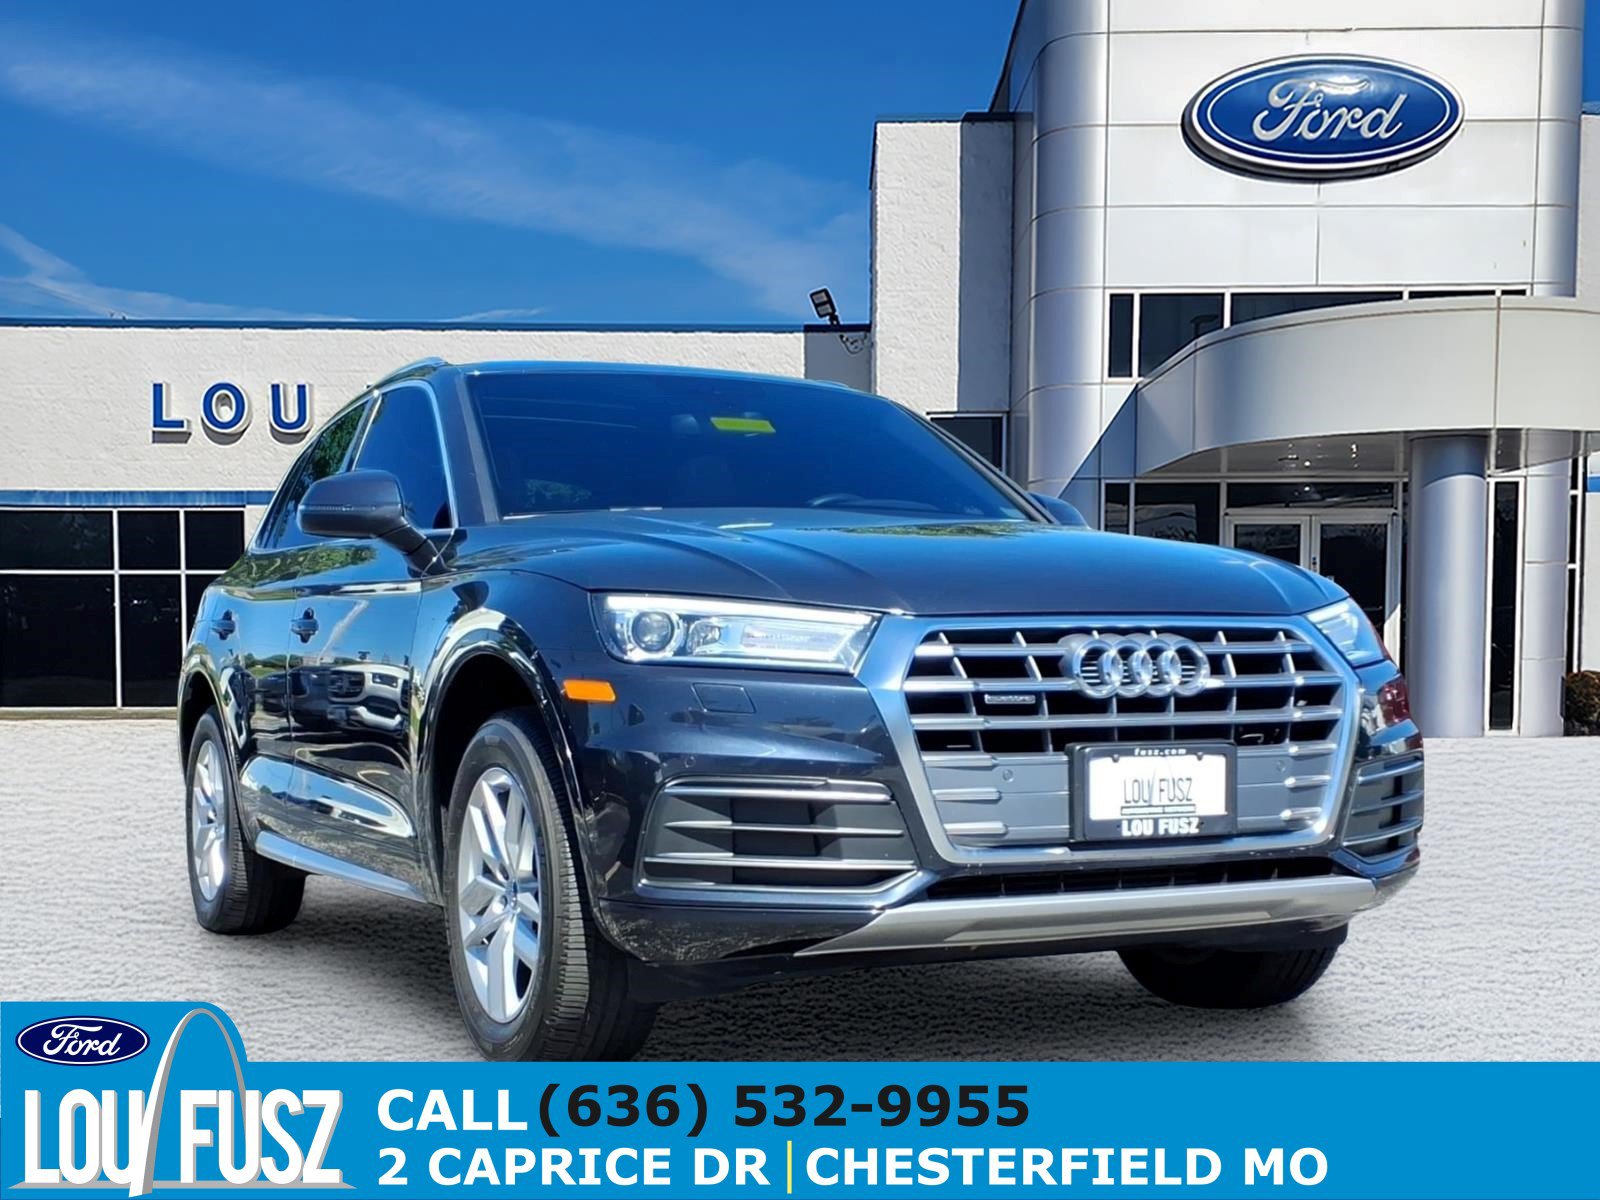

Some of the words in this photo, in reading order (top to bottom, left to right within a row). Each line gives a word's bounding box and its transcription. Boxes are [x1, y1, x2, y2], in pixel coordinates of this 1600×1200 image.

[1252, 78, 1408, 142] Ford
[151, 381, 313, 434] LOU
[1134, 747, 1187, 757] fusz.com
[1123, 778, 1151, 804] LOU
[1159, 777, 1193, 802] FUSZ
[1121, 818, 1155, 837] LOU
[1158, 817, 1200, 835] FUSZ
